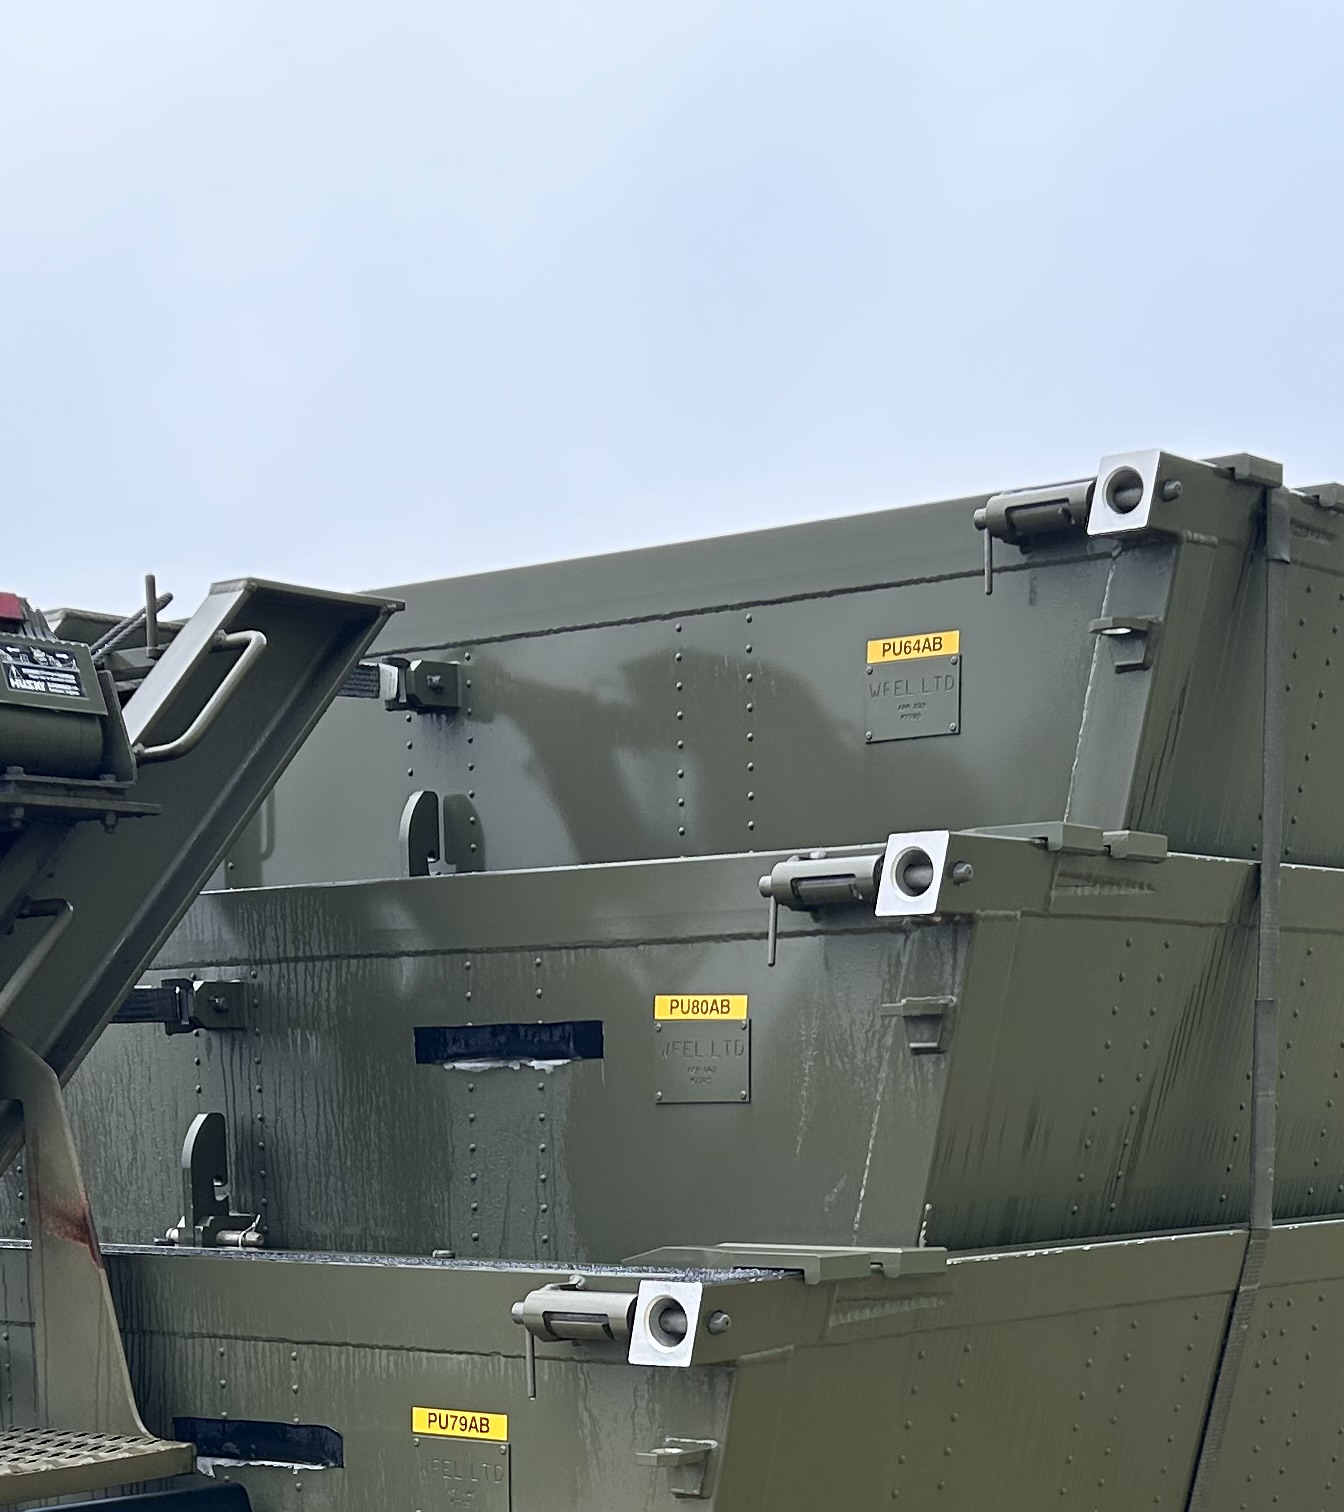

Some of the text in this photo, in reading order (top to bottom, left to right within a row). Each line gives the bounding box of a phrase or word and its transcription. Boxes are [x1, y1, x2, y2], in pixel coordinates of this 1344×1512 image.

[882, 637, 943, 657] PU64AB
[669, 999, 731, 1015] PU80AB
[427, 1412, 490, 1434] PU79AB
